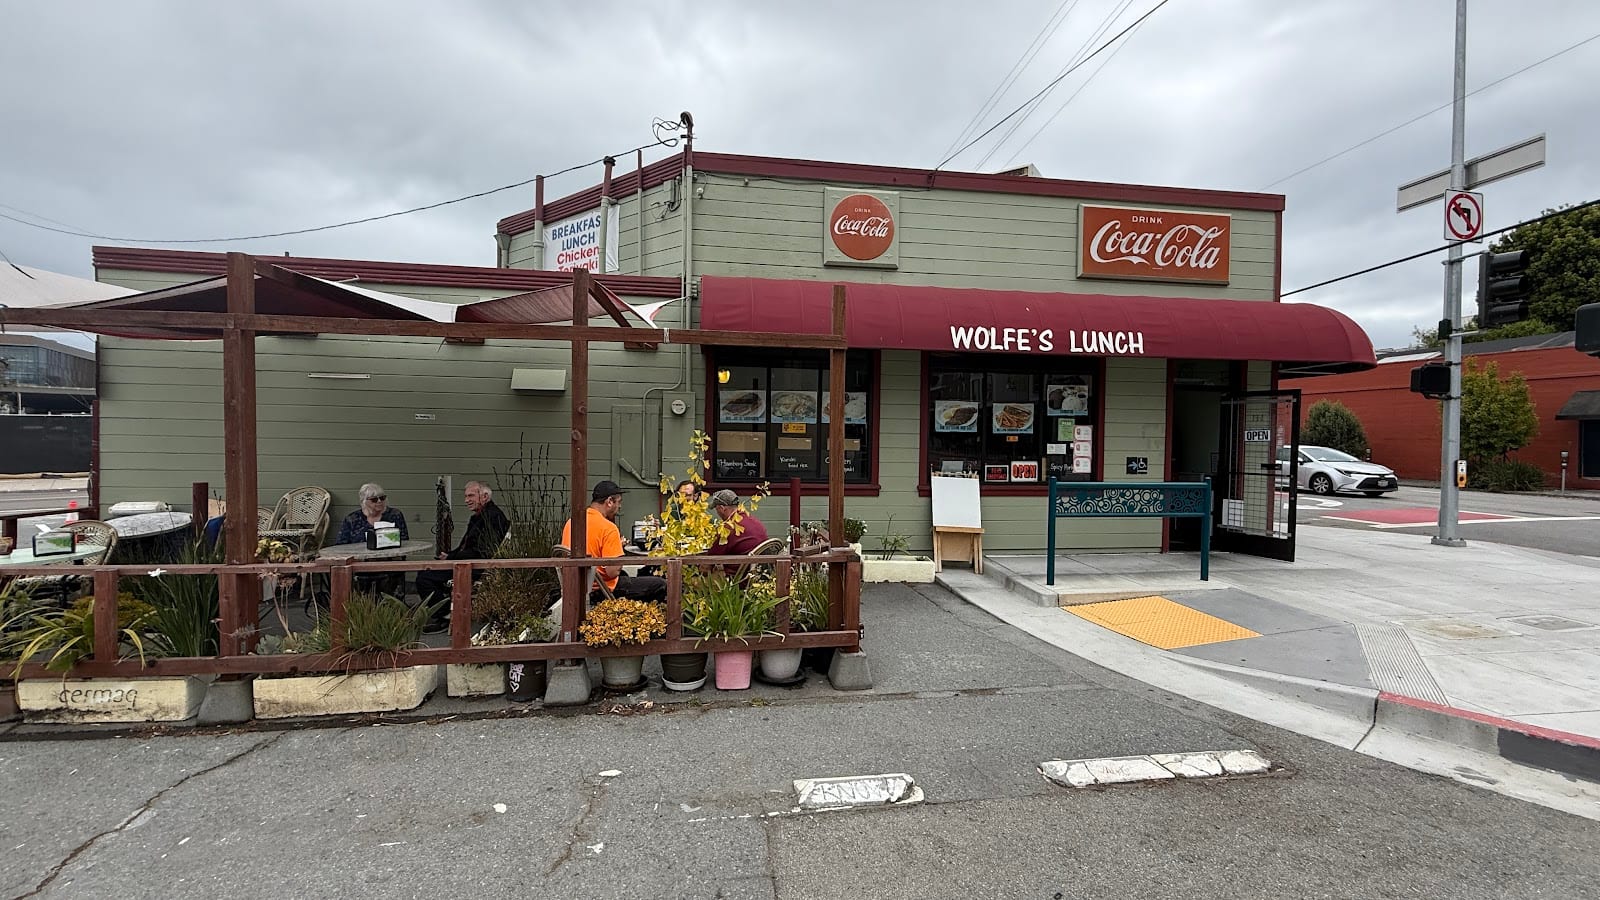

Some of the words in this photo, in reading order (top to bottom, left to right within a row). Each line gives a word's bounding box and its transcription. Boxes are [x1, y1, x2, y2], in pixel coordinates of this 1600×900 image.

[552, 214, 601, 241] BREAKFAS
[834, 214, 890, 238] Coca-Cola
[1132, 215, 1163, 225] DRINK
[561, 231, 596, 252] LUNCH
[1089, 220, 1226, 269] Coca-Cola
[557, 246, 600, 265] Chicken
[558, 257, 599, 273] Teraki
[950, 325, 1054, 352] WOLFE'S
[1069, 329, 1145, 354] LUNCH
[1246, 430, 1269, 441] OPEN
[1012, 463, 1037, 479] OPEN
